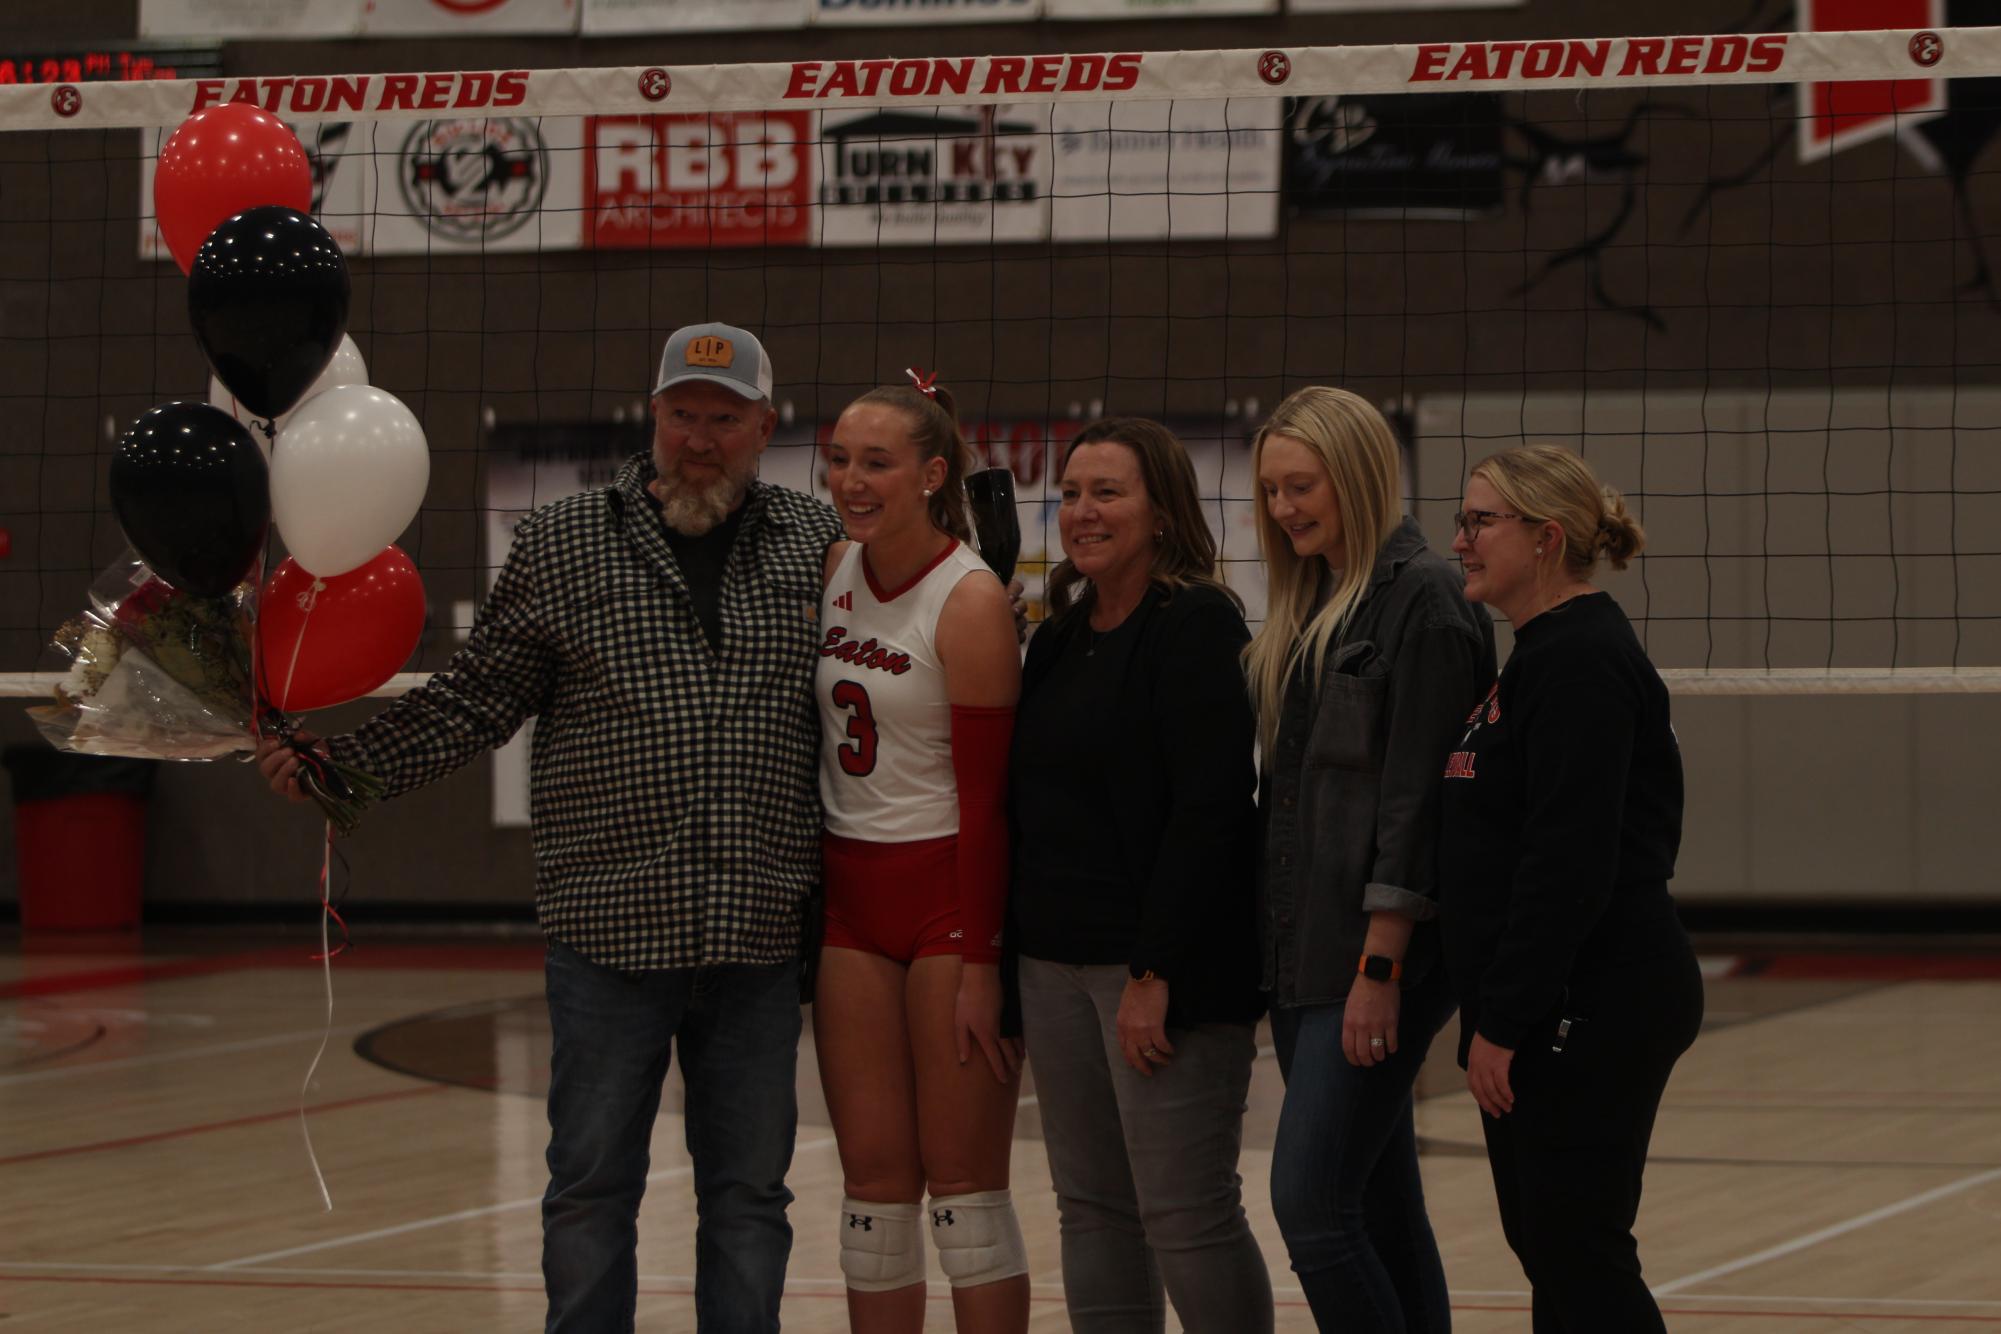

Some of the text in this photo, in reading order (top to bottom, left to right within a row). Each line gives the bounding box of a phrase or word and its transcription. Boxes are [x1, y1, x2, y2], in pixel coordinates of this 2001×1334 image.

[783, 54, 1143, 99] EATON REDS
[1409, 35, 1788, 82] EATON REDS
[189, 71, 529, 115] EATON REDS
[597, 118, 800, 192] RBB
[817, 625, 912, 675] Eaton
[832, 679, 879, 777] 3
